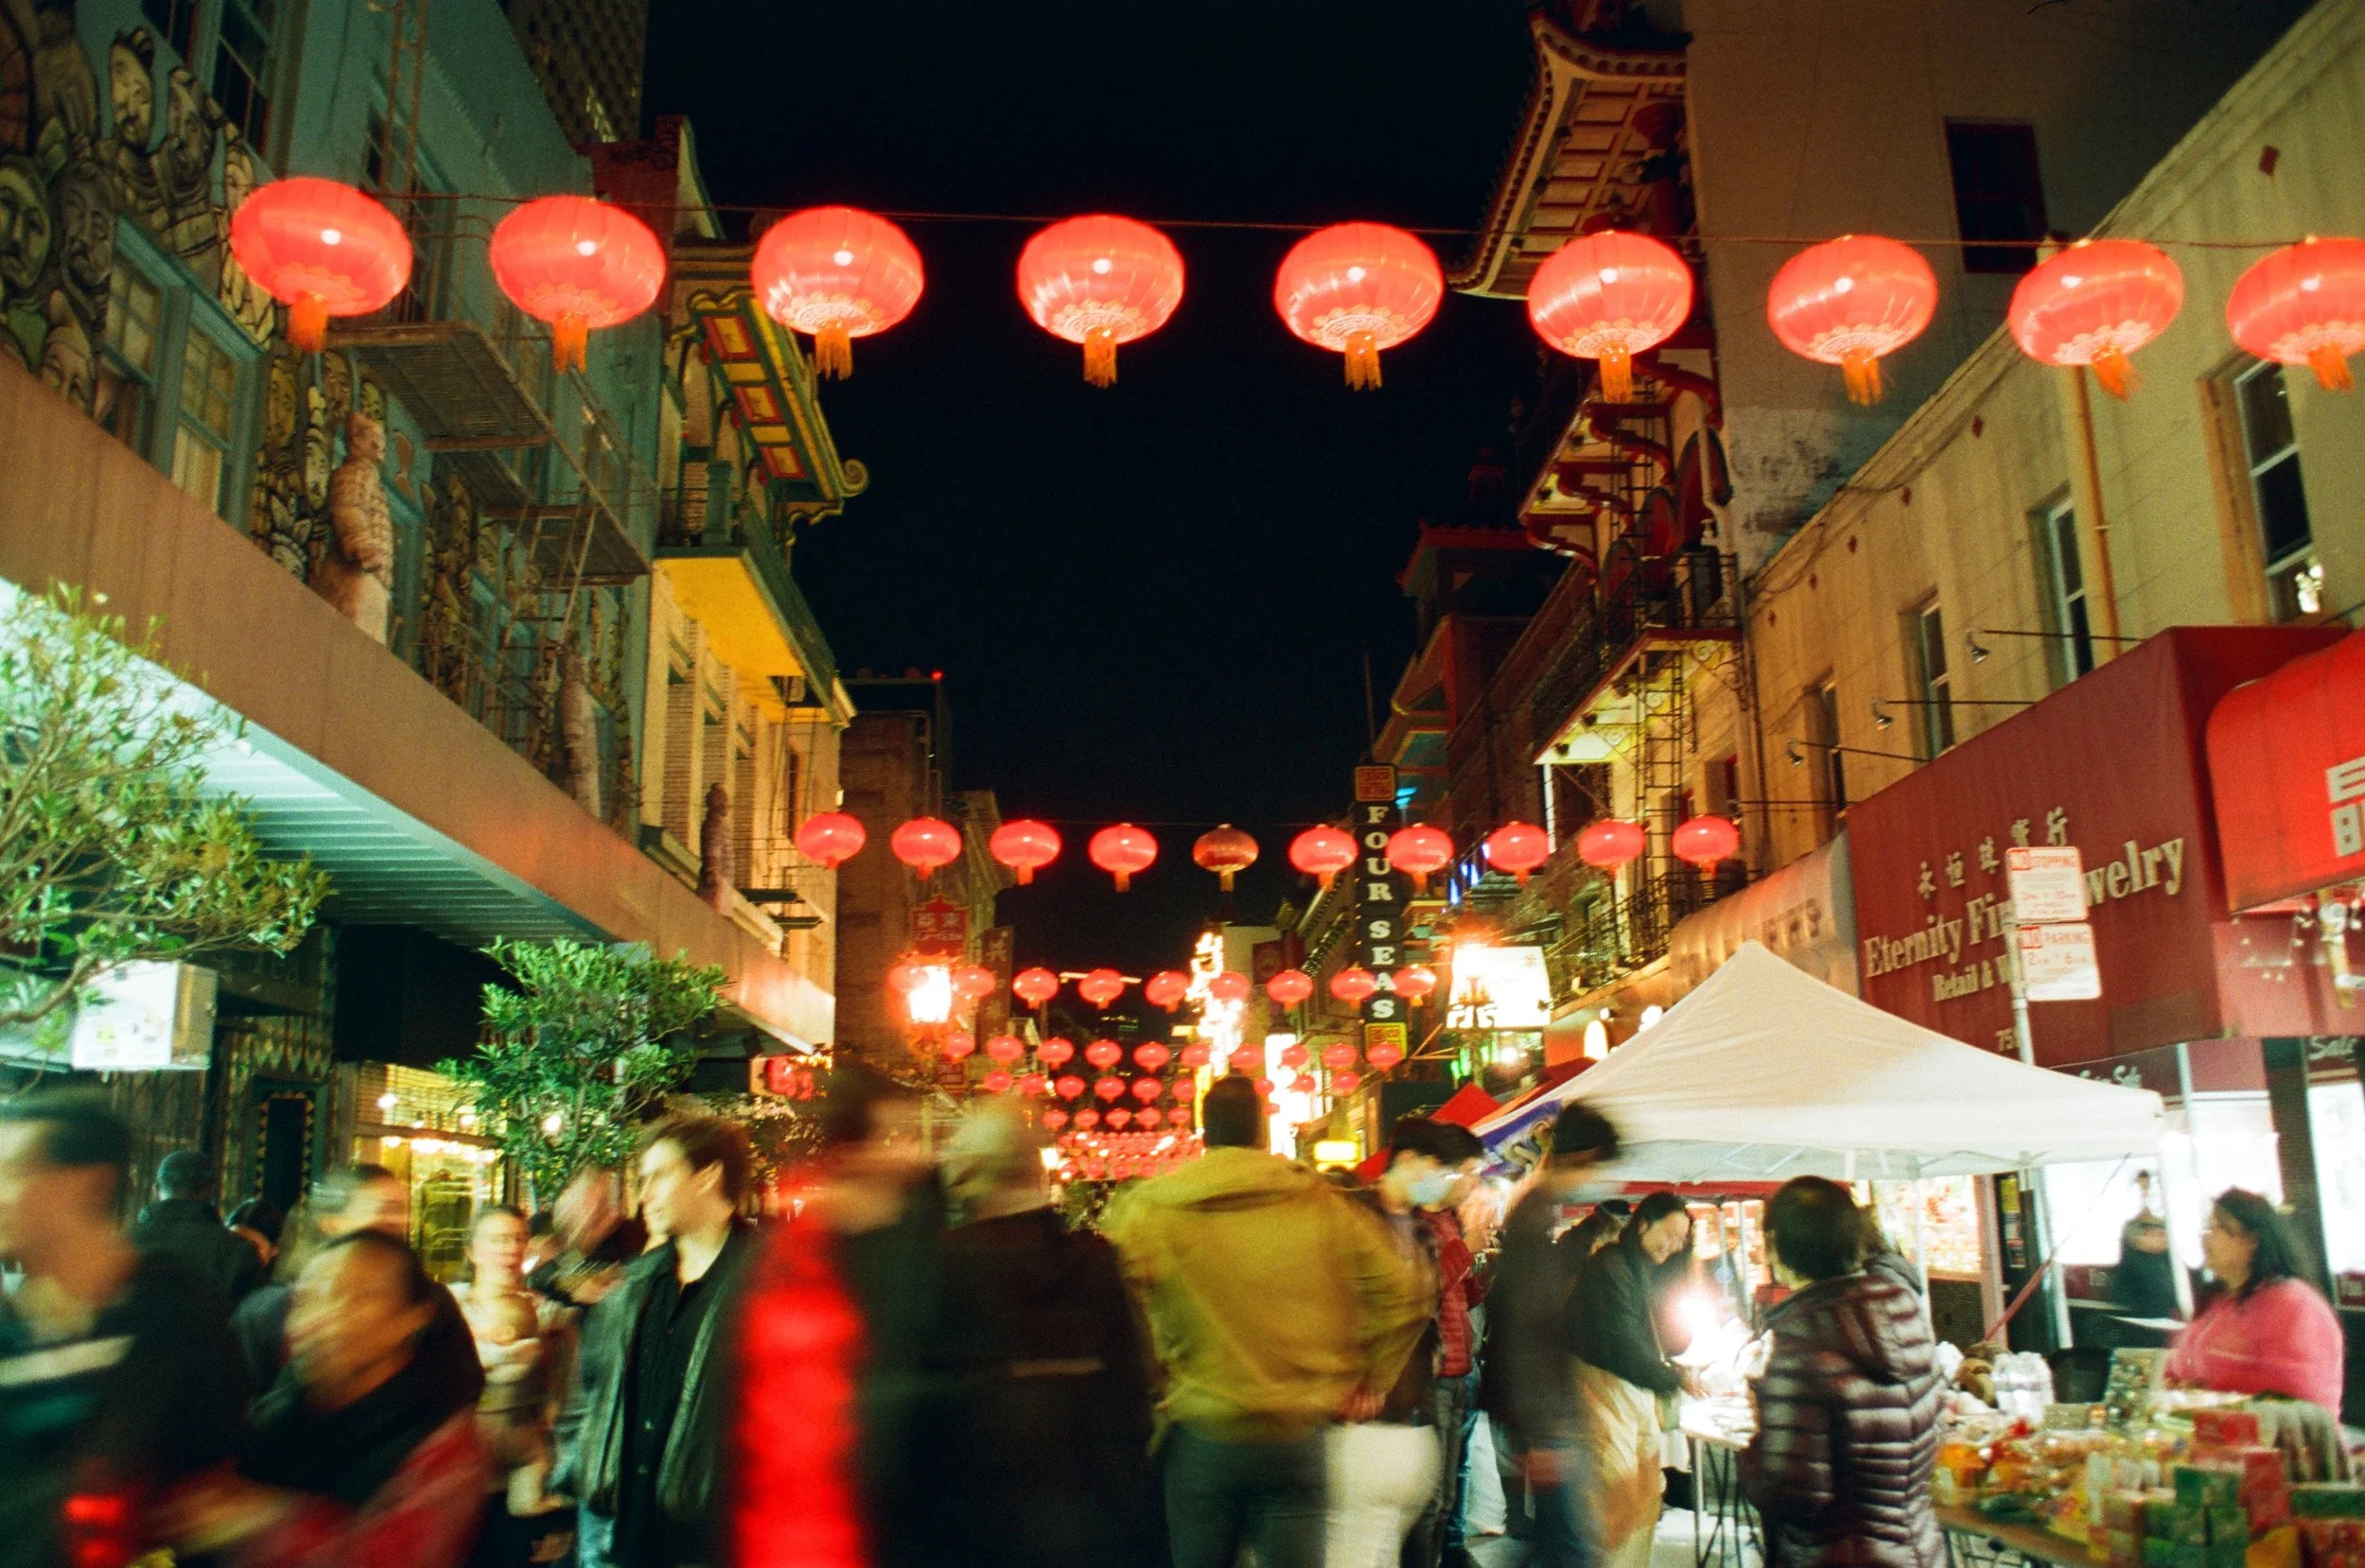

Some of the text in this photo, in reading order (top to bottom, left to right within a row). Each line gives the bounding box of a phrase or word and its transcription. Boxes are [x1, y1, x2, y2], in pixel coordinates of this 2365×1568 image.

[1364, 806, 1393, 901] FOUR
[1864, 915, 1963, 978] Eternity
[1966, 893, 2014, 945] Fin
[2081, 837, 2185, 907] welry
[1369, 920, 1397, 1019] SEAS
[1933, 964, 1978, 1002] Retail
